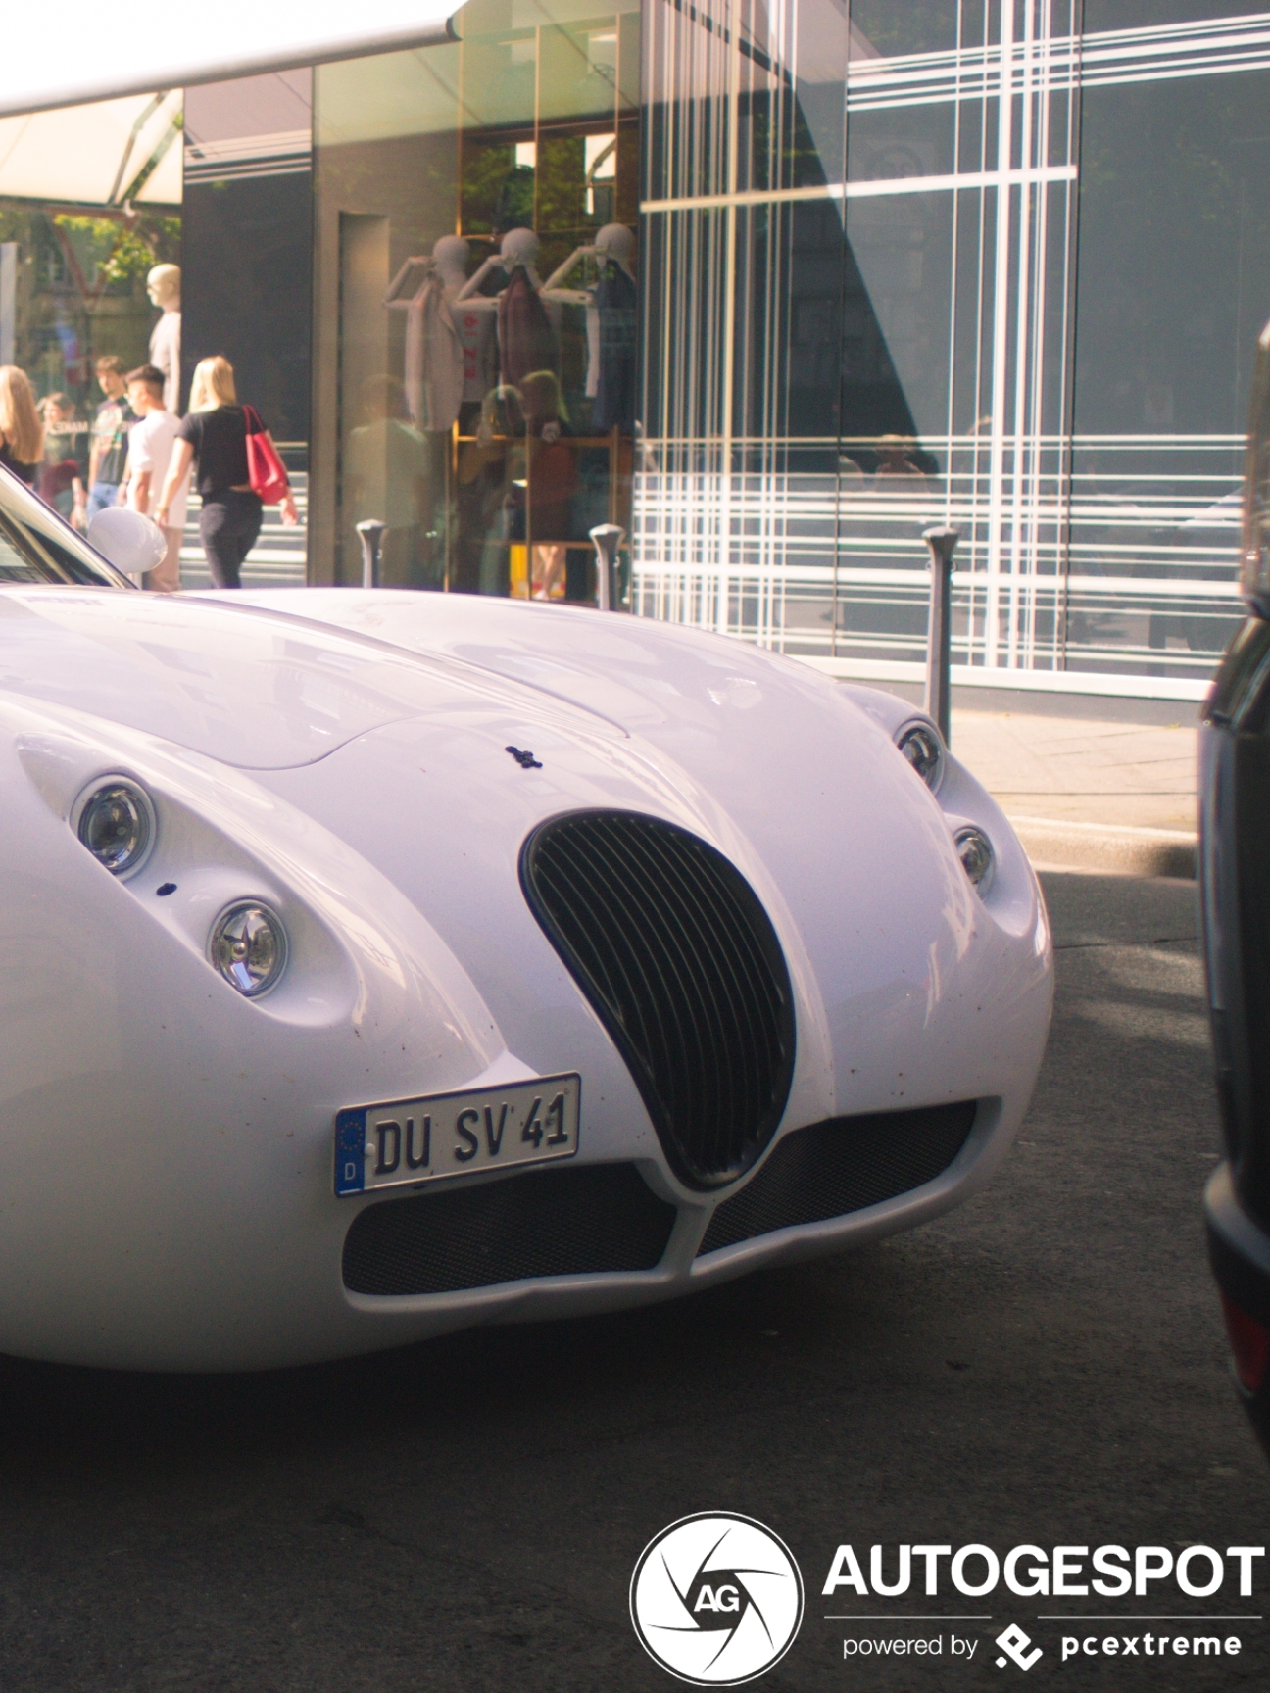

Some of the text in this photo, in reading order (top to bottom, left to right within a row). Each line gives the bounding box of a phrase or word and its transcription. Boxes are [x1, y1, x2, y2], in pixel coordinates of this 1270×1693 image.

[374, 1091, 568, 1175] DU SV 41
[344, 1162, 356, 1181] D
